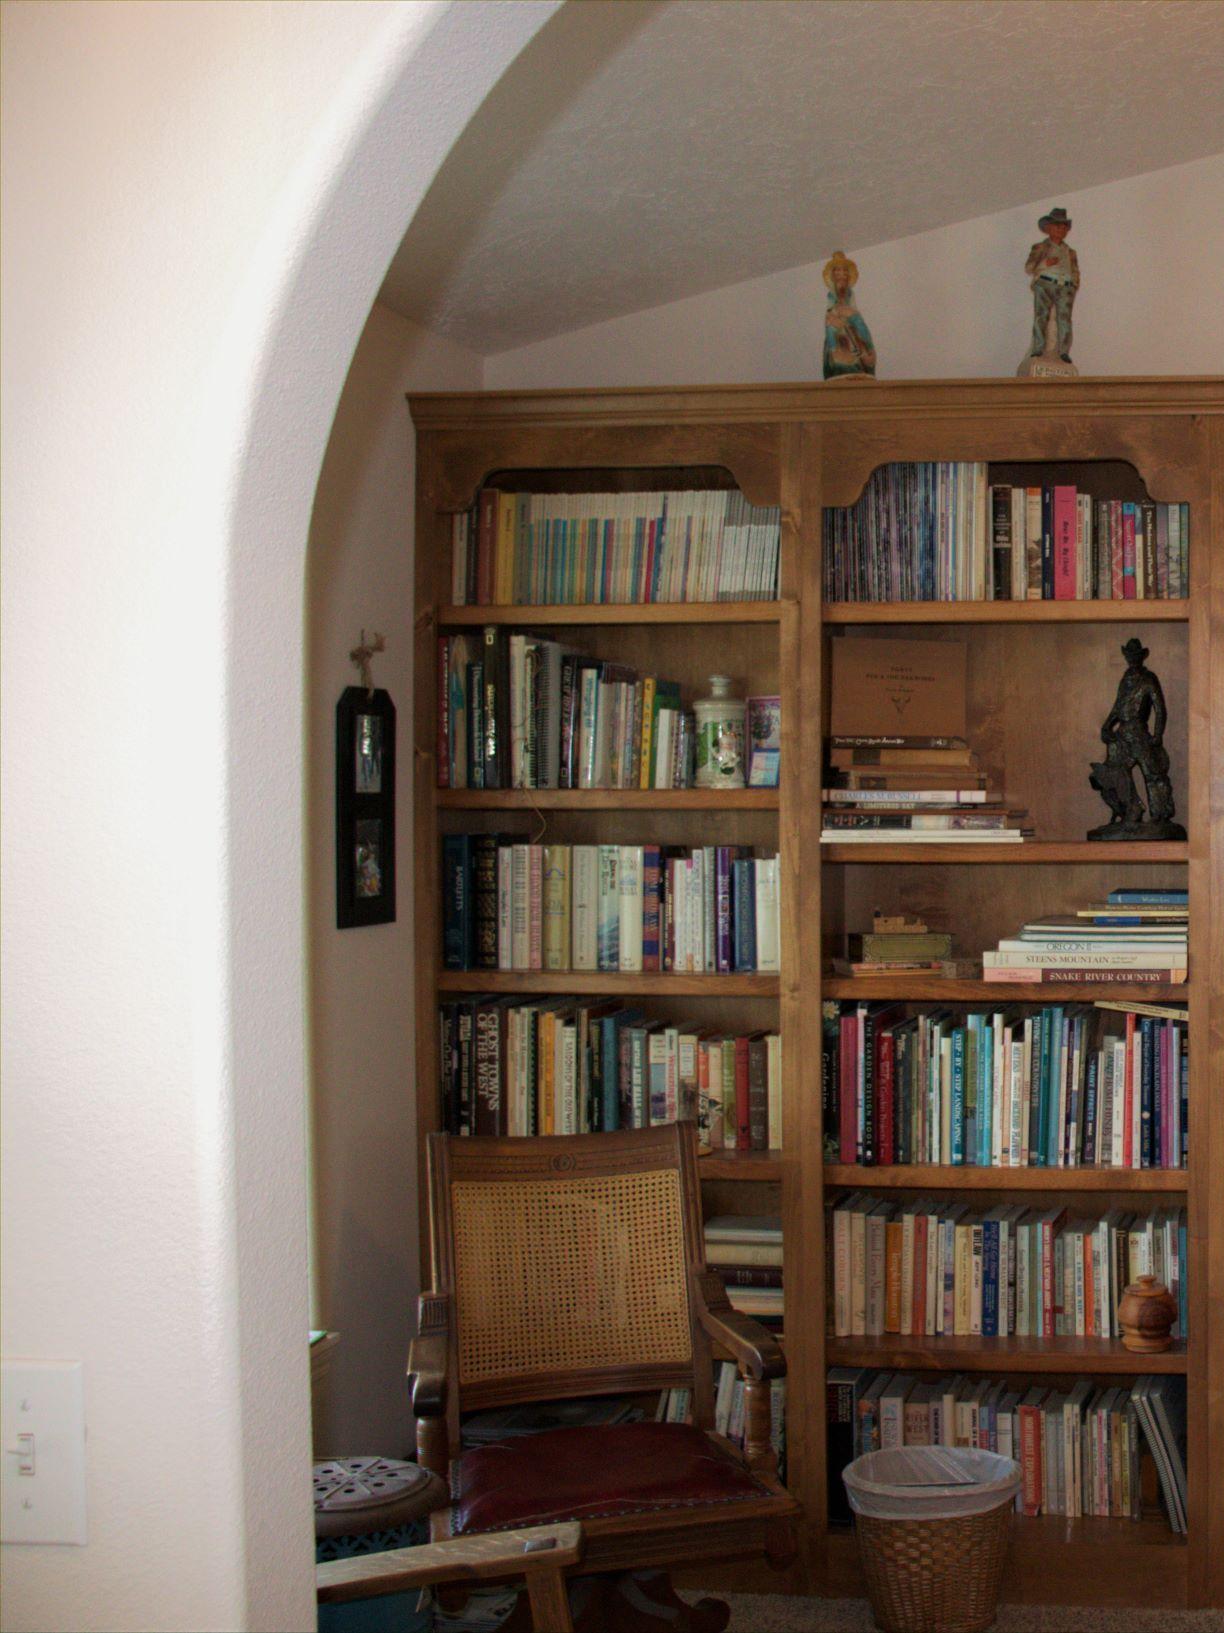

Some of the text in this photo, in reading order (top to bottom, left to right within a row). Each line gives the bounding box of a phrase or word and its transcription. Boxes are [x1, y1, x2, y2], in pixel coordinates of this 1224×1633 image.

[1025, 956, 1110, 964] STEENS MOUNTAIN
[1049, 972, 1162, 982] SNAKE RIVER COUNTRY
[476, 1012, 488, 1101] OF THE WEST
[954, 1034, 962, 1052] STEP
[487, 1012, 499, 1111] GHOST TOWNS
[1024, 1416, 1034, 1456] NORTHWEST
